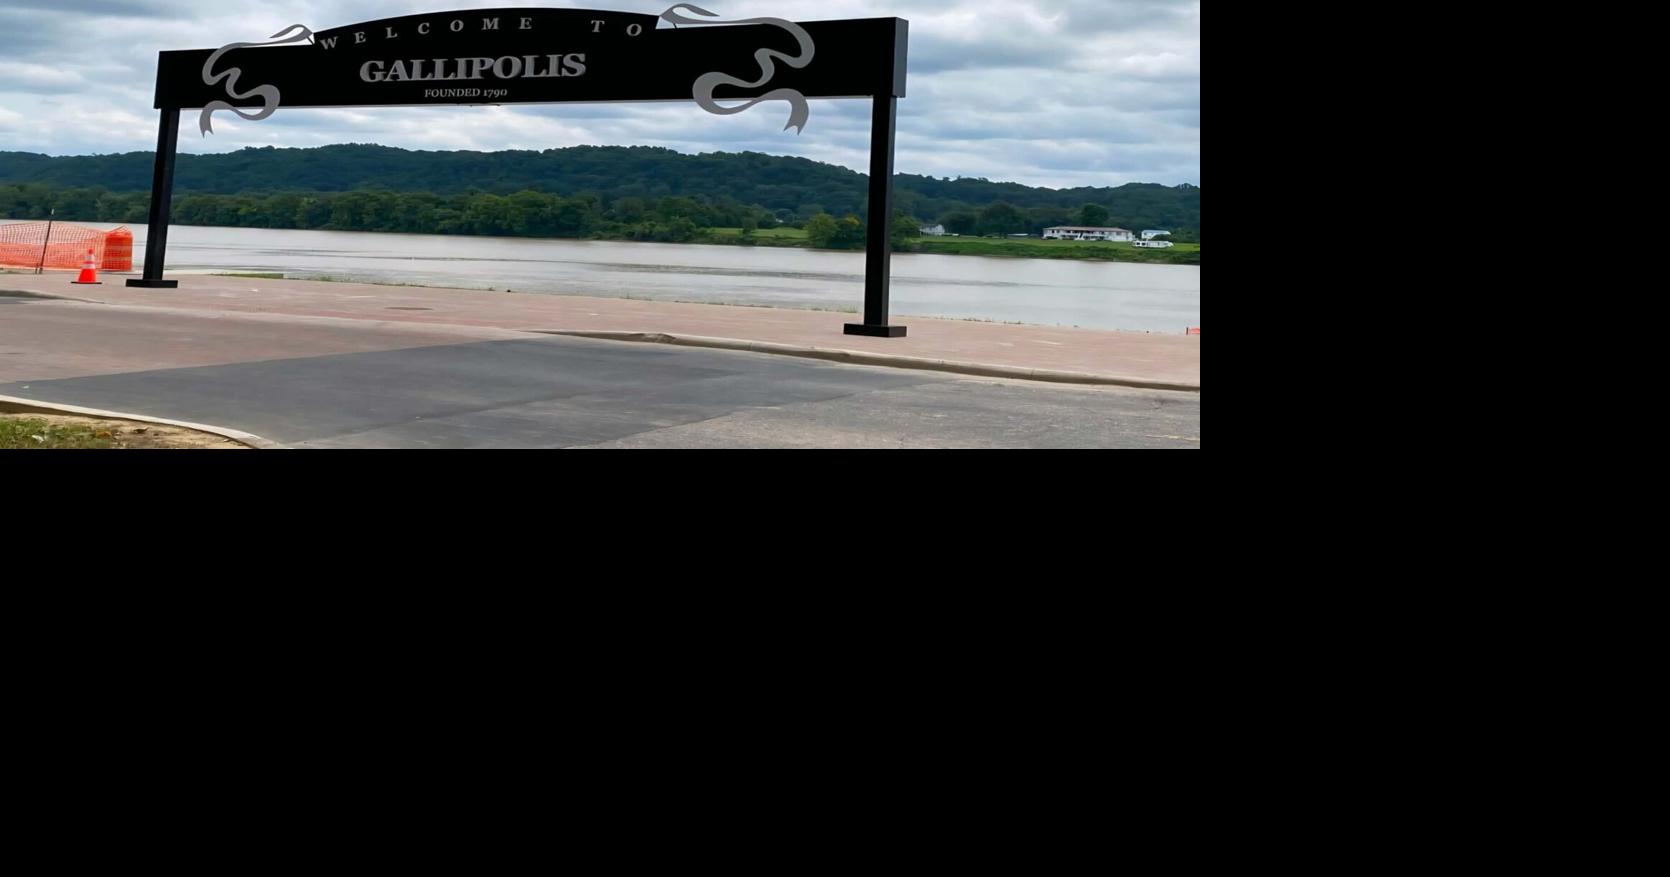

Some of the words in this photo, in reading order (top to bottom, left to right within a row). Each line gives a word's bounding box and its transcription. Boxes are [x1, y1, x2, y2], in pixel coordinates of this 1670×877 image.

[320, 17, 532, 50] WELCOME
[591, 19, 642, 37] TO
[360, 53, 586, 83] GALLIPOLIS
[424, 88, 481, 98] FOUNDED
[483, 88, 508, 98] 1790
